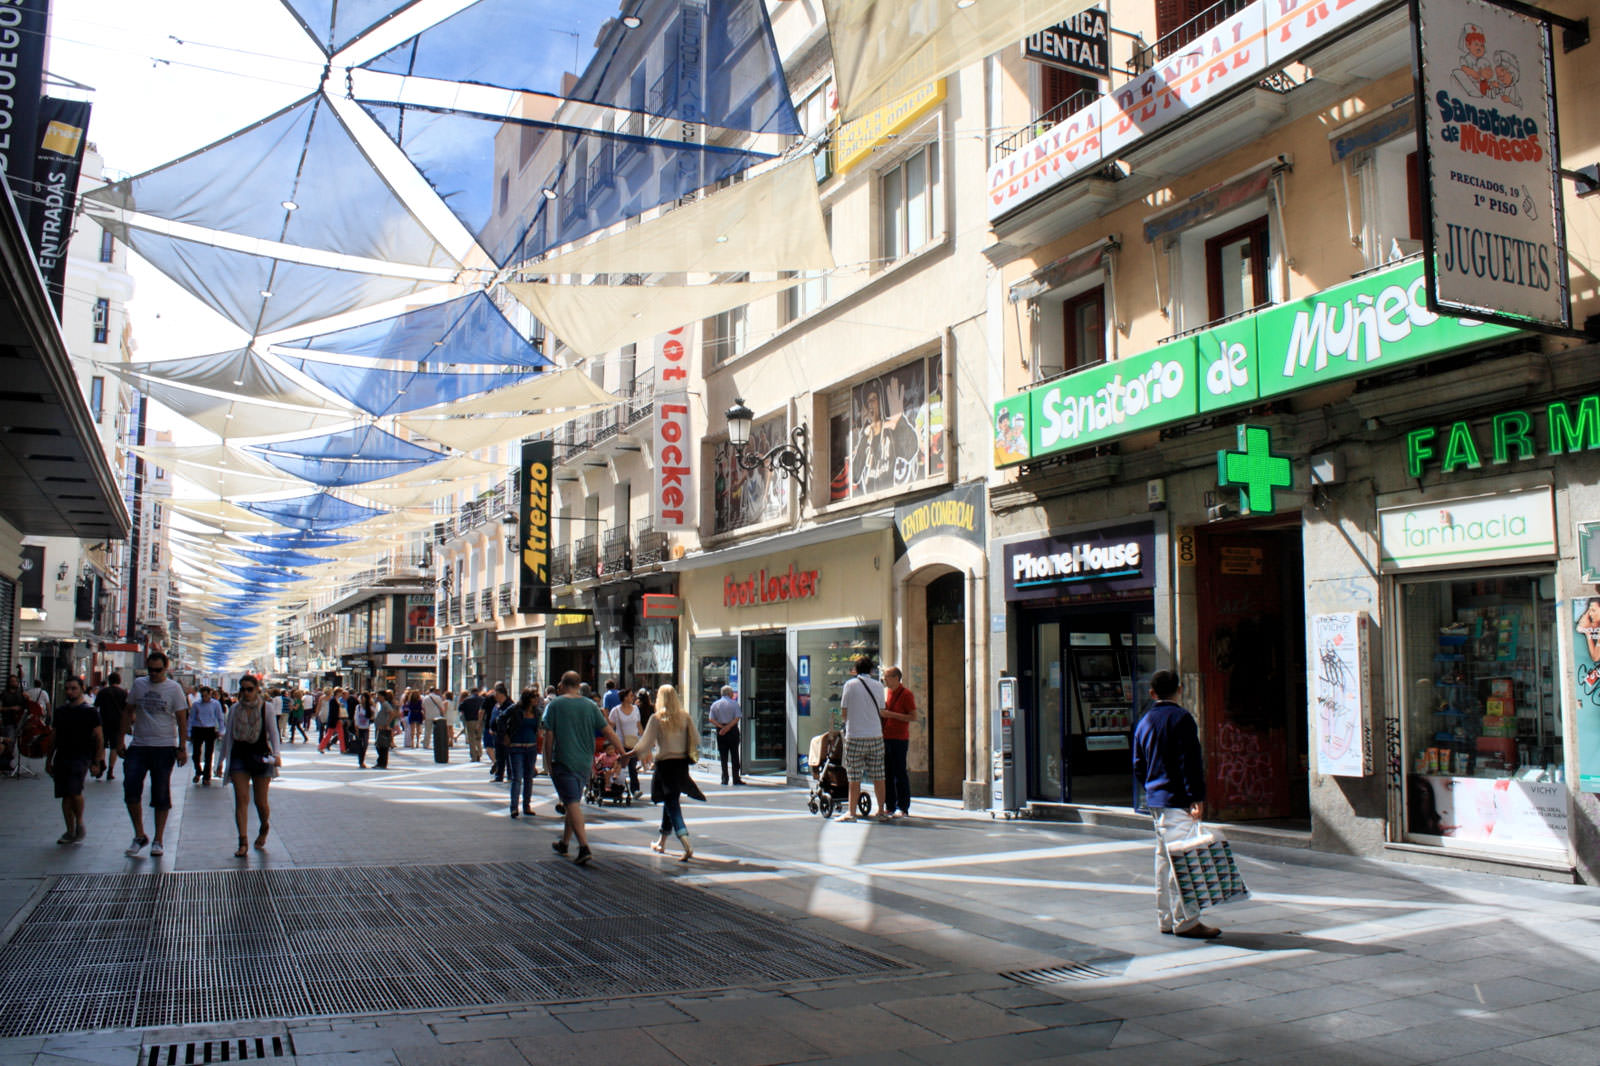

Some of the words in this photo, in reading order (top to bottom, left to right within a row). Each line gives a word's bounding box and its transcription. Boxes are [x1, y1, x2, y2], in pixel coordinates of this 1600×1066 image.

[1029, 31, 1105, 69] DENTAL
[1117, 21, 1250, 136] DENTAL
[1436, 90, 1538, 139] Sanatorio
[1441, 124, 1459, 142] de
[1460, 123, 1543, 162] Muñecos
[1450, 170, 1508, 196] PRECIADOS,
[1510, 187, 1520, 198] 19
[1489, 198, 1518, 216] PISO
[40, 171, 67, 268] ENTRADAS
[1445, 223, 1550, 292] JUGUETES
[1039, 360, 1184, 448] Sanatorio
[1206, 341, 1249, 395] de
[1407, 395, 1600, 478] FARM
[661, 404, 692, 525] Locker
[523, 462, 548, 584] Atrezzo
[901, 504, 930, 542] CENTRO
[930, 500, 975, 531] COMERCIAL
[1401, 511, 1527, 547] farmacia
[723, 572, 757, 608] Foot
[760, 563, 819, 603] Locker
[1530, 785, 1558, 796] VICHY
